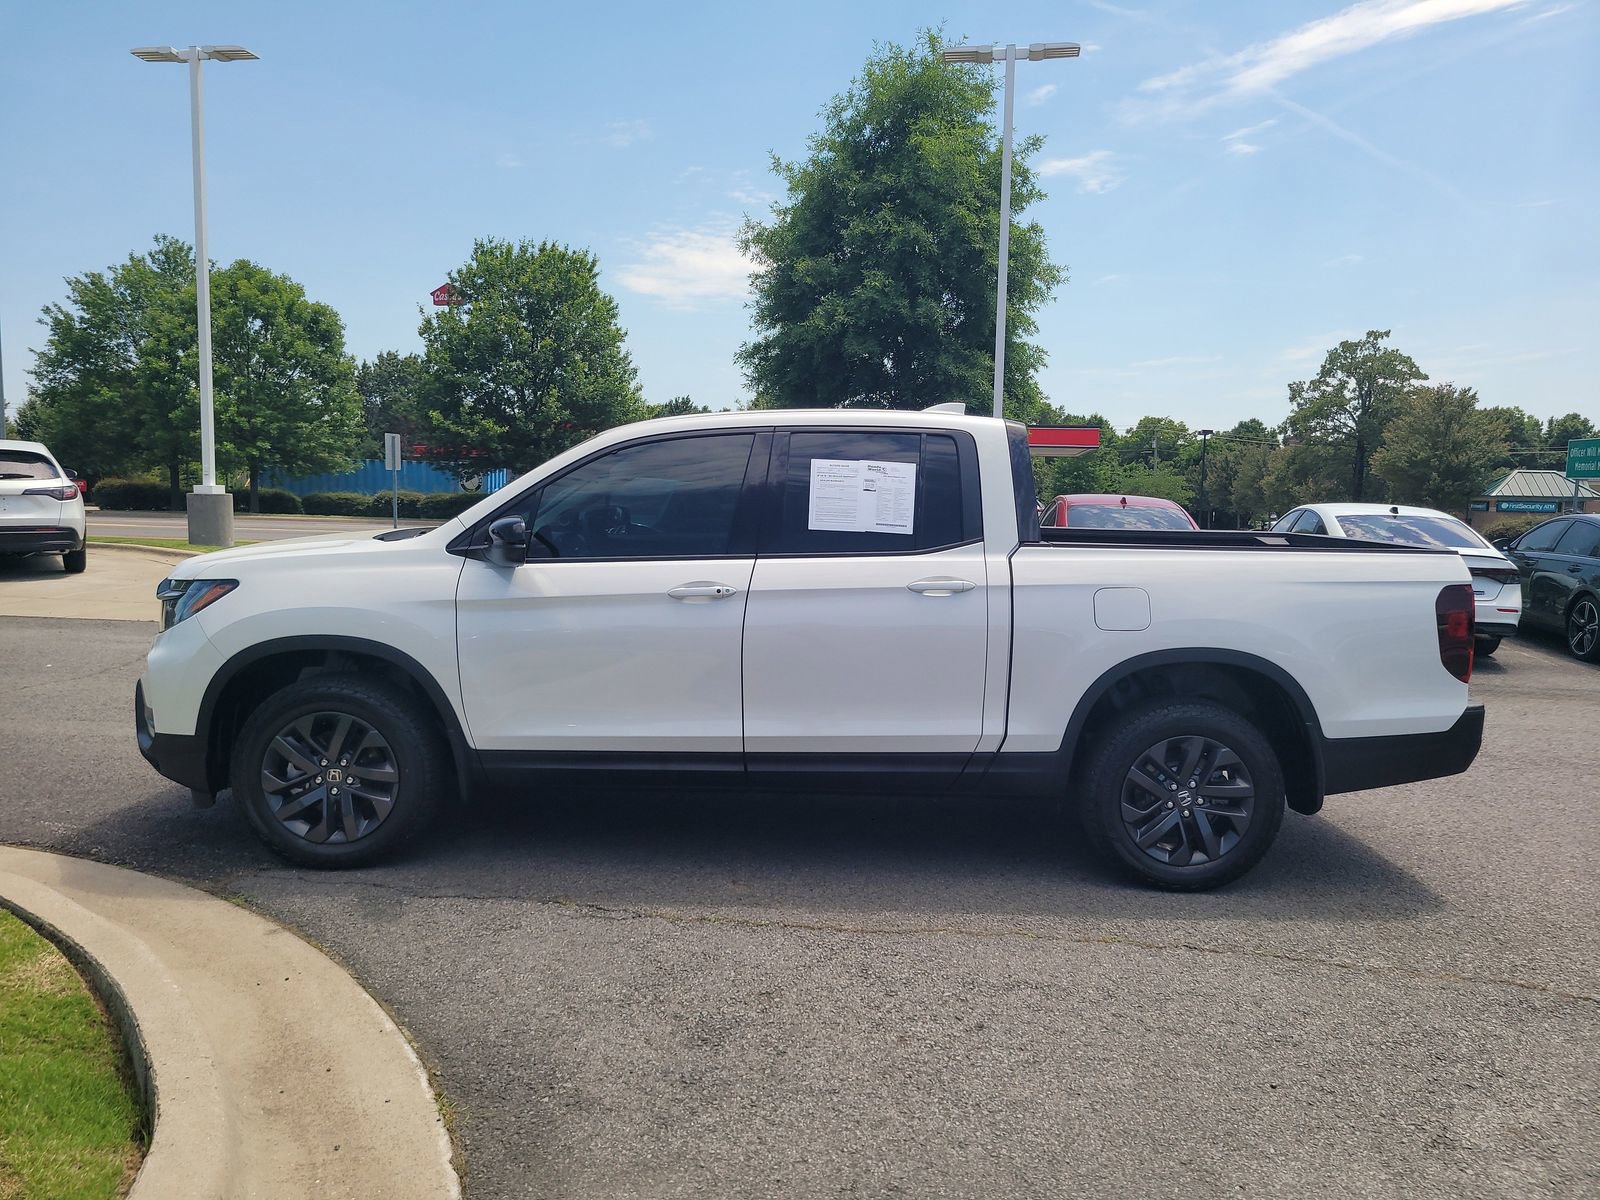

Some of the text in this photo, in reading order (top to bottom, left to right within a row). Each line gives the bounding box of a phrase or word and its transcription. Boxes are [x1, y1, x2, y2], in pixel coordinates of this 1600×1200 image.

[1570, 447, 1586, 457] Officer
[1587, 447, 1596, 456] Will
[1575, 461, 1596, 470] Memorial
